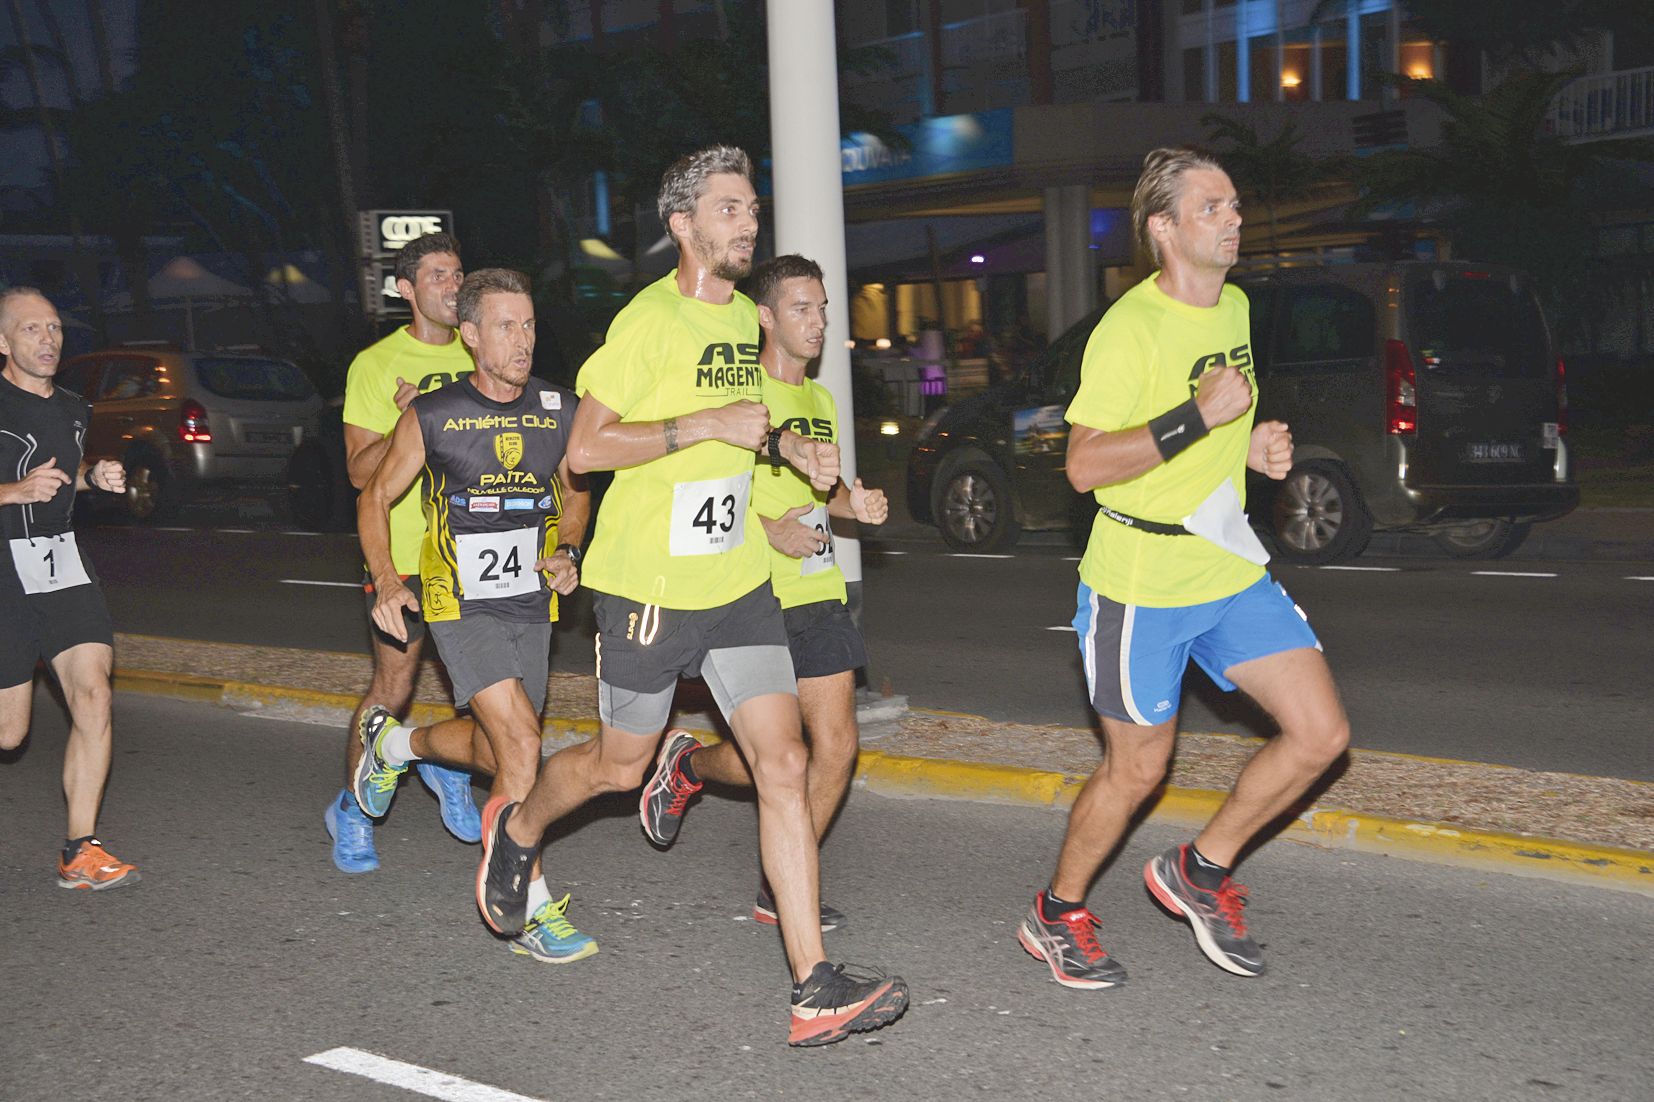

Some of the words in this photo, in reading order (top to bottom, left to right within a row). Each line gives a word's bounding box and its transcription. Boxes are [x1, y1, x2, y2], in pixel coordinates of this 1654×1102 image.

[697, 343, 760, 365] AS
[1188, 344, 1252, 381] AS
[725, 388, 749, 397] TRAIL
[521, 414, 558, 430] Club
[779, 417, 833, 437] AS
[692, 494, 736, 534] 43
[43, 549, 55, 577] 1
[478, 545, 522, 582] 24
